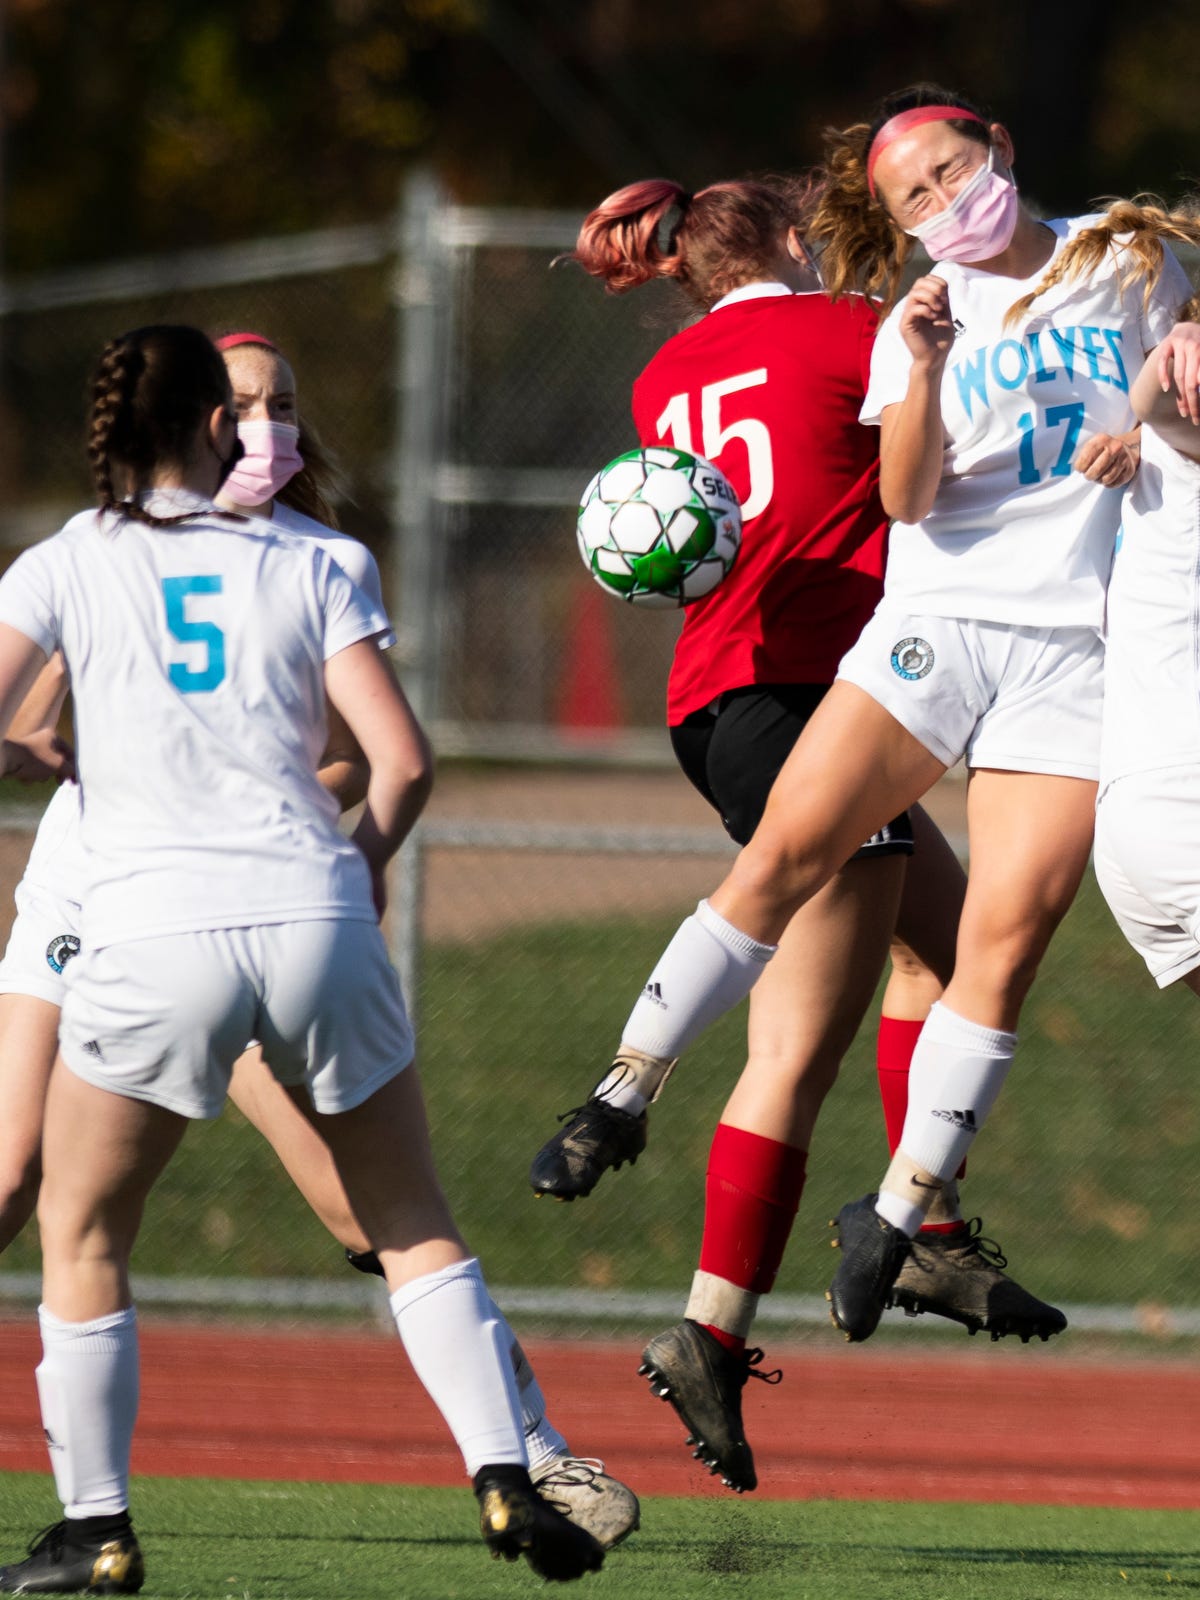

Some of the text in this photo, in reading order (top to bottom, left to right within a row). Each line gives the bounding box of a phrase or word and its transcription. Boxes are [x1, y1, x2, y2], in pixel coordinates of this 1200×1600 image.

[952, 326, 1129, 424] WOLVES
[1016, 402, 1085, 485] 17
[161, 574, 226, 695] 5
[931, 1110, 979, 1135] adidas
